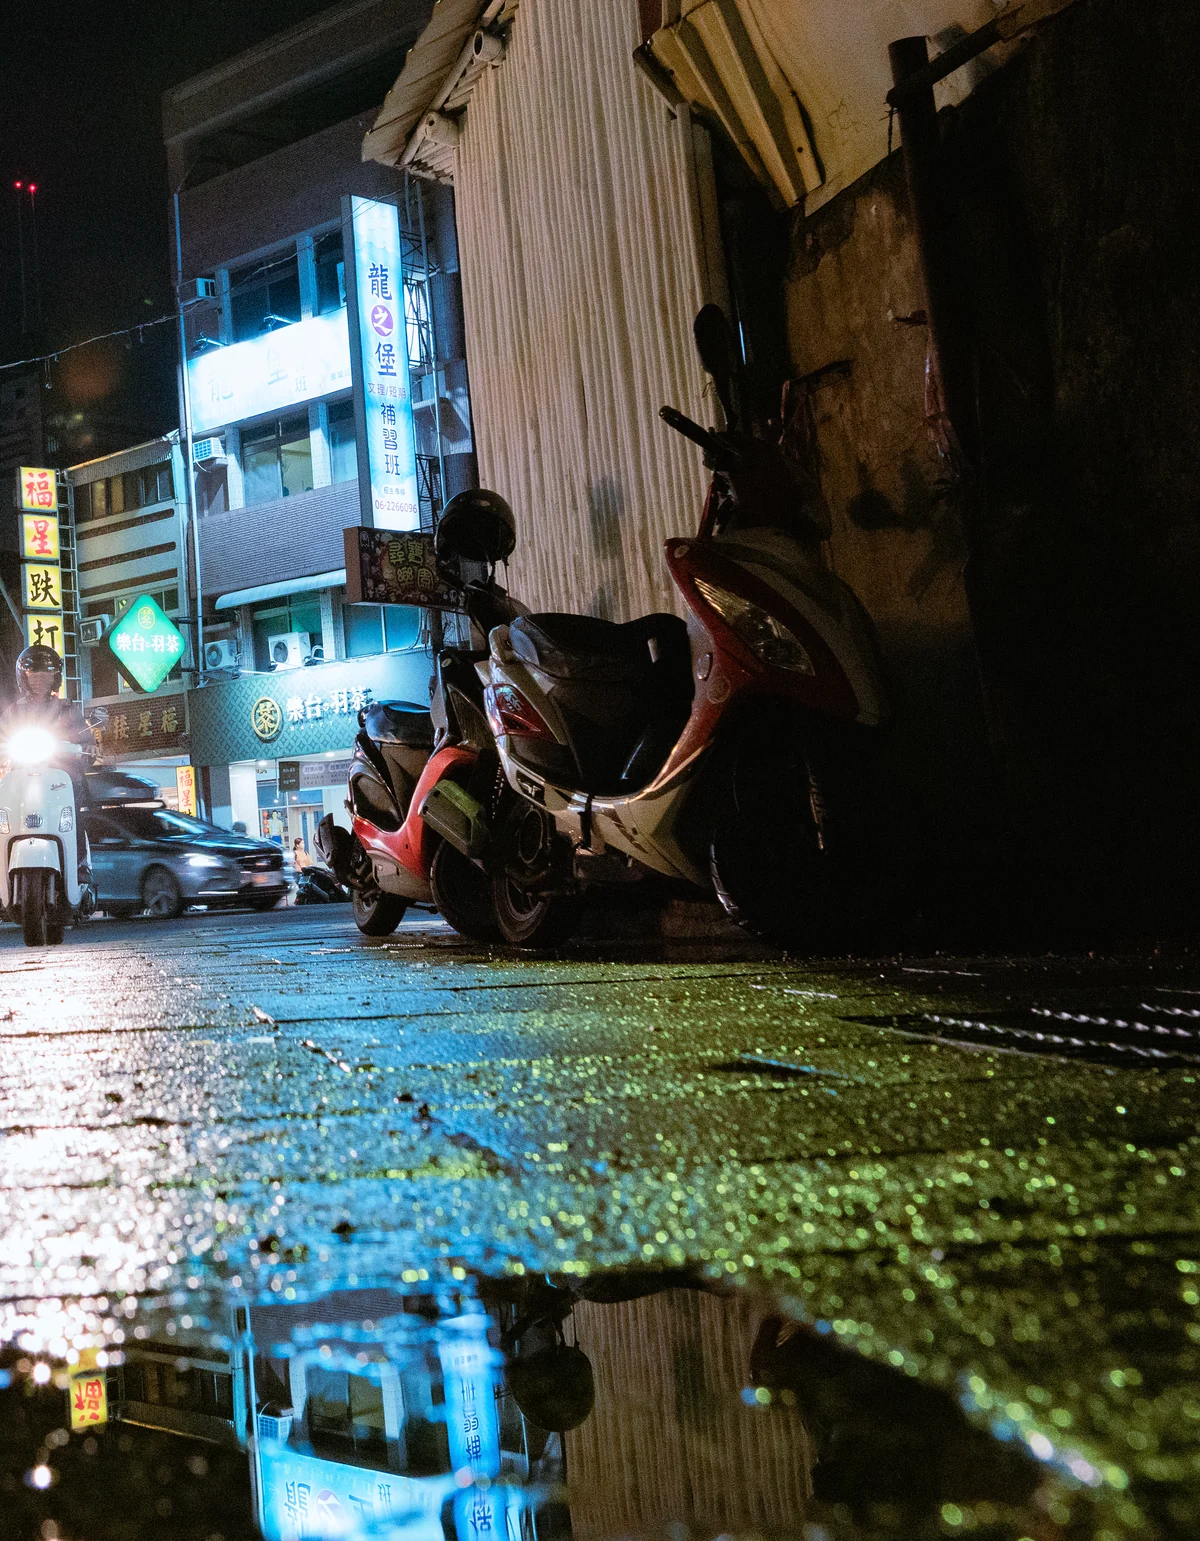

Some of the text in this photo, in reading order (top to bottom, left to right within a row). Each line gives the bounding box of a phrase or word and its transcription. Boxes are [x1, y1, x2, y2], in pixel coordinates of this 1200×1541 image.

[368, 262, 397, 377] 龍之堡
[380, 402, 401, 477] 補習班
[374, 499, 418, 514] 06-2266096
[179, 768, 193, 817] 福星
